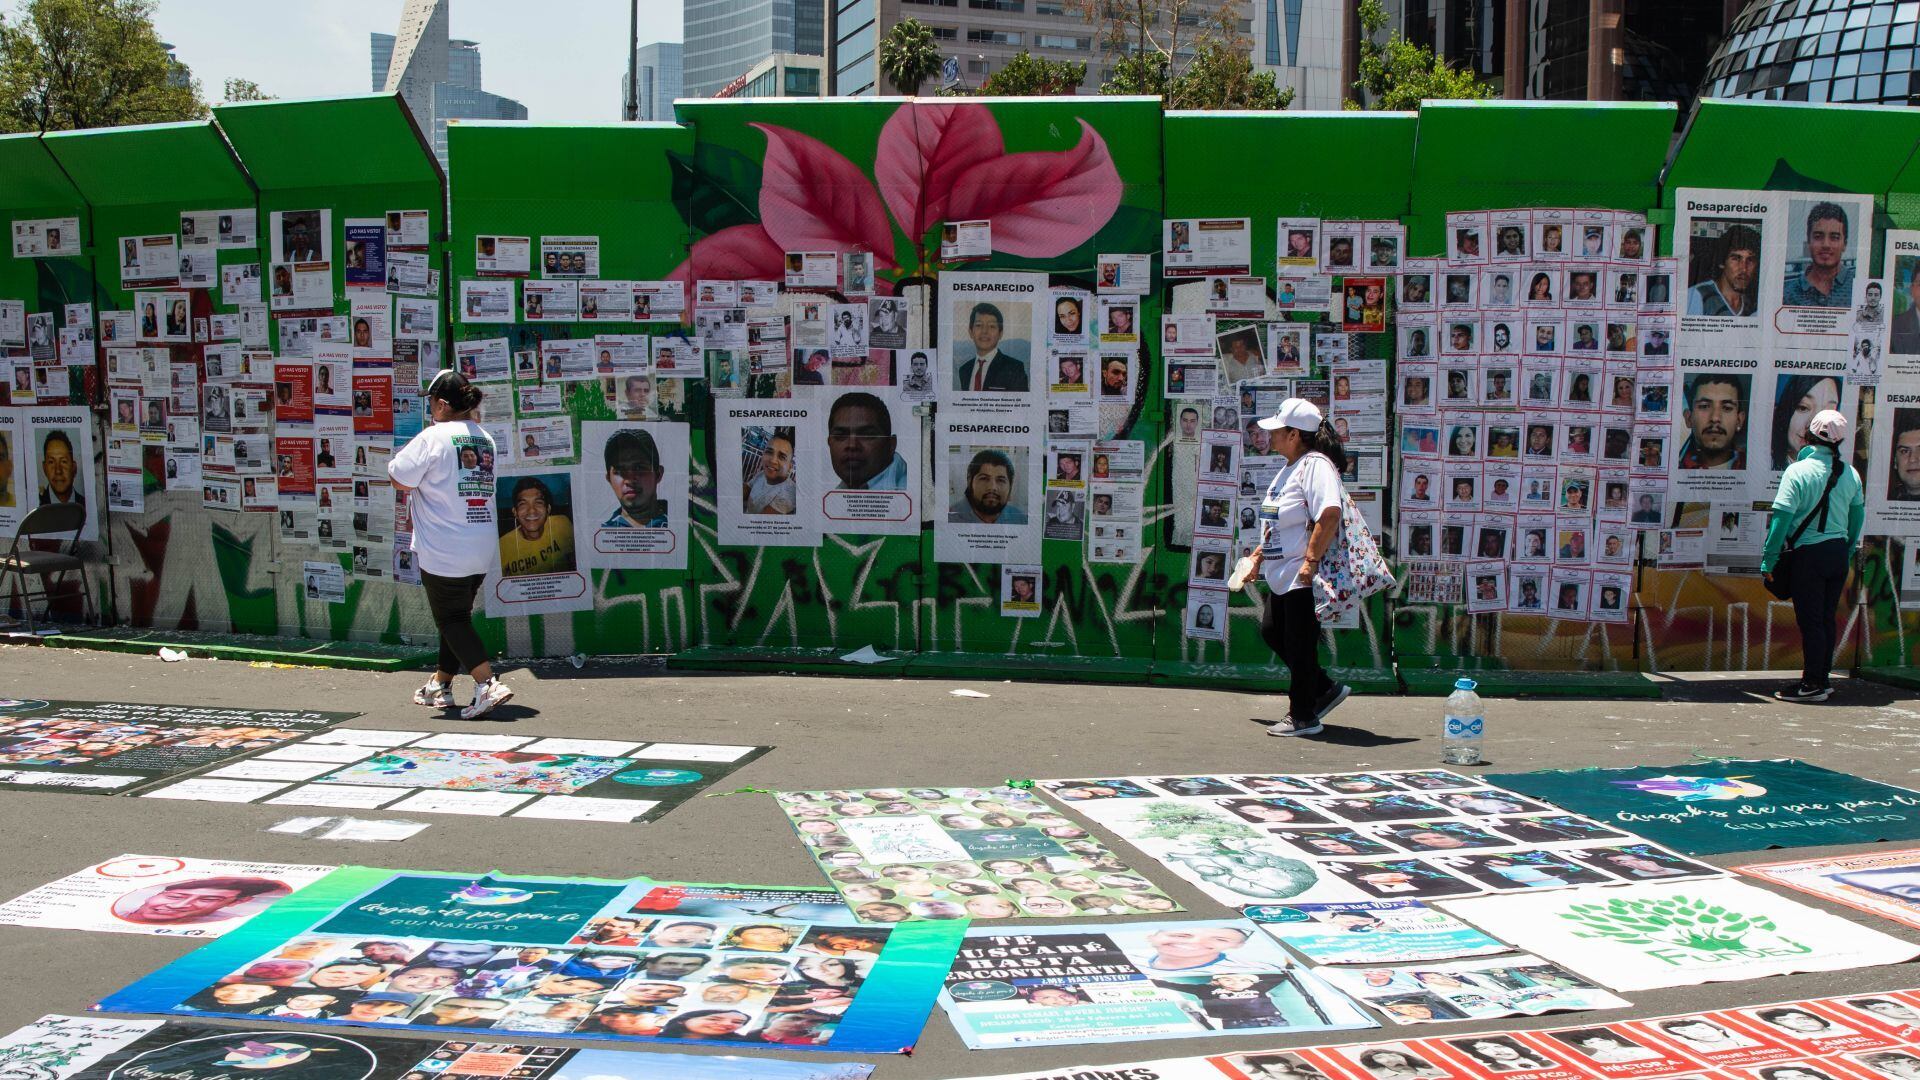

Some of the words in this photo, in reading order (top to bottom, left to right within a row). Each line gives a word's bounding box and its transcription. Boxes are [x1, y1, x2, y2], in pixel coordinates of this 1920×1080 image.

[1687, 201, 1768, 213] Desaparecido
[953, 283, 1035, 292] DESAPARECIDO
[1681, 358, 1758, 368] DESAPARECIDO
[31, 416, 83, 424] DESAPARECIDO
[729, 410, 808, 418] DESAPARECIDO
[949, 424, 1030, 434] DESAPARECIDO
[1737, 805, 1775, 815] de
[1782, 802, 1829, 814] pie
[439, 907, 468, 917] de
[468, 907, 507, 922] pie
[989, 935, 1037, 947] TE
[955, 941, 1107, 959] USCARÉ
[968, 955, 1092, 969] HASTA
[945, 964, 1136, 981] ENCONTRARTE
[1070, 975, 1091, 983] HAS
[1601, 1061, 1660, 1073] HÉCTOR
[1663, 1059, 1685, 1068] A.
